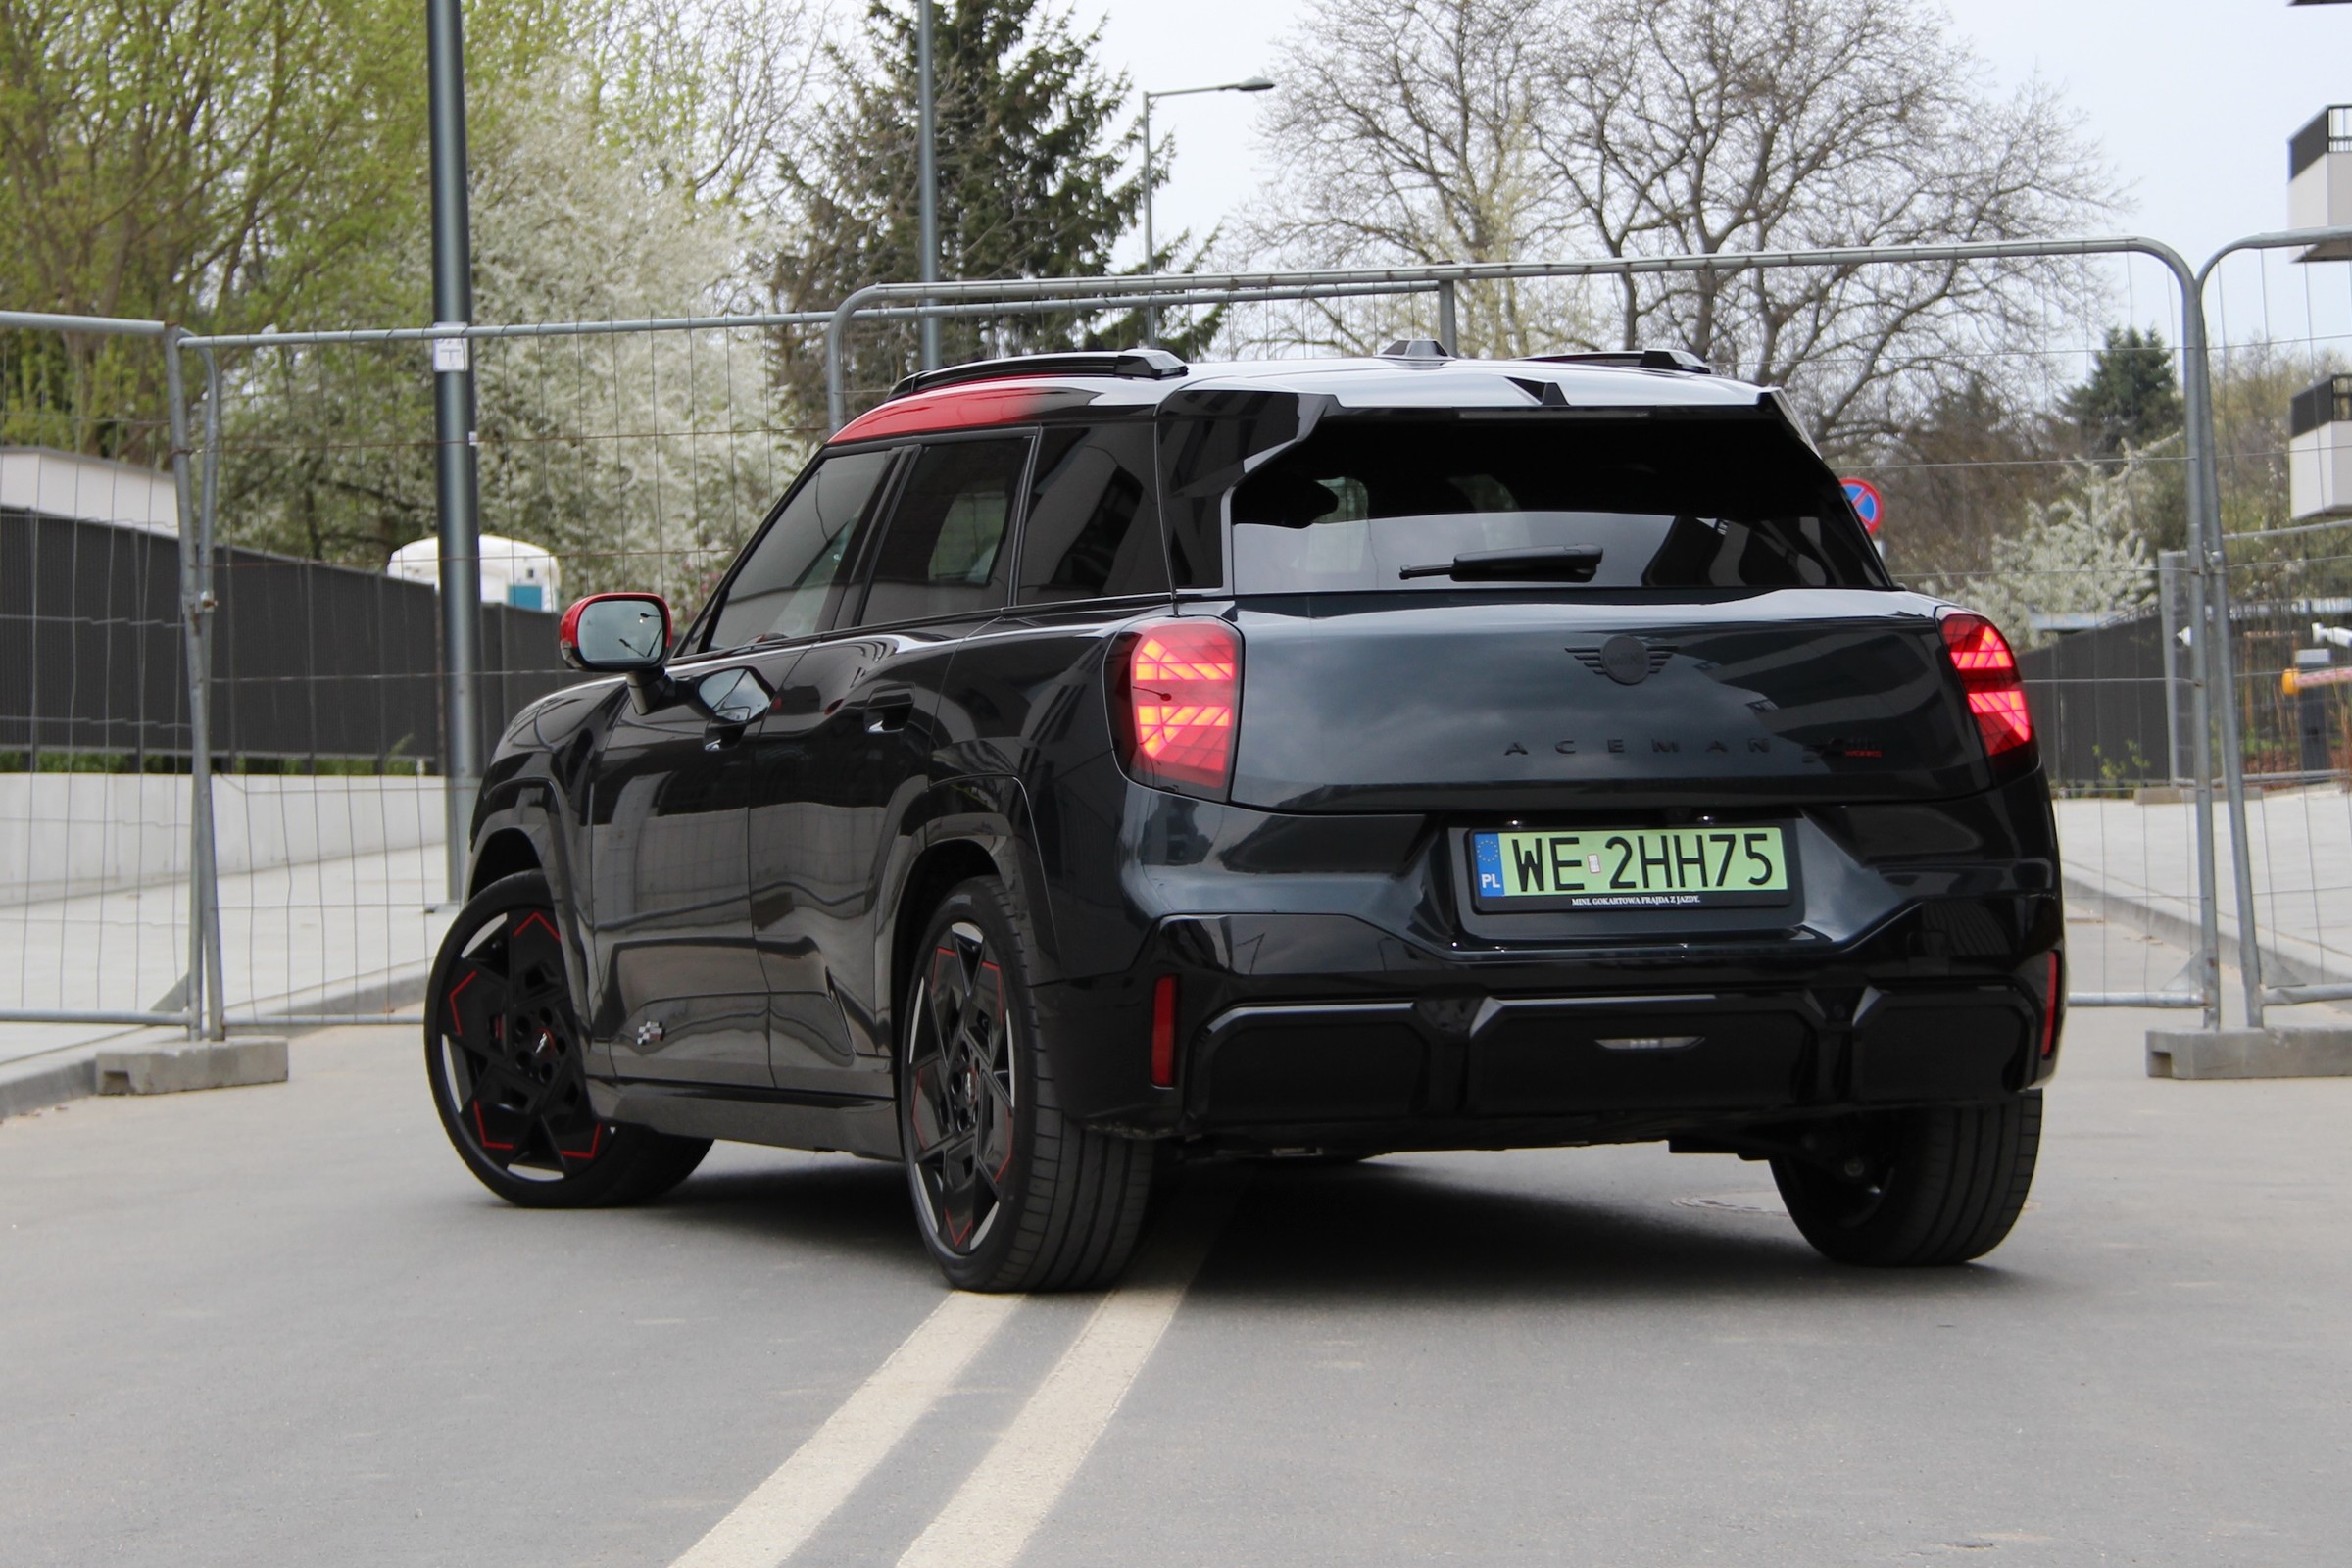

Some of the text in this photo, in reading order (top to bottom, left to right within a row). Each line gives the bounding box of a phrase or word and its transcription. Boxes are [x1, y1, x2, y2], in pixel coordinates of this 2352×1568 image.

[1504, 738, 1772, 756] ACEMAN
[1511, 833, 1773, 892] WE 2HH75
[1481, 873, 1500, 889] PL
[1592, 897, 1641, 906] GOKARTOWA
[1642, 896, 1669, 906] FRAJDA
